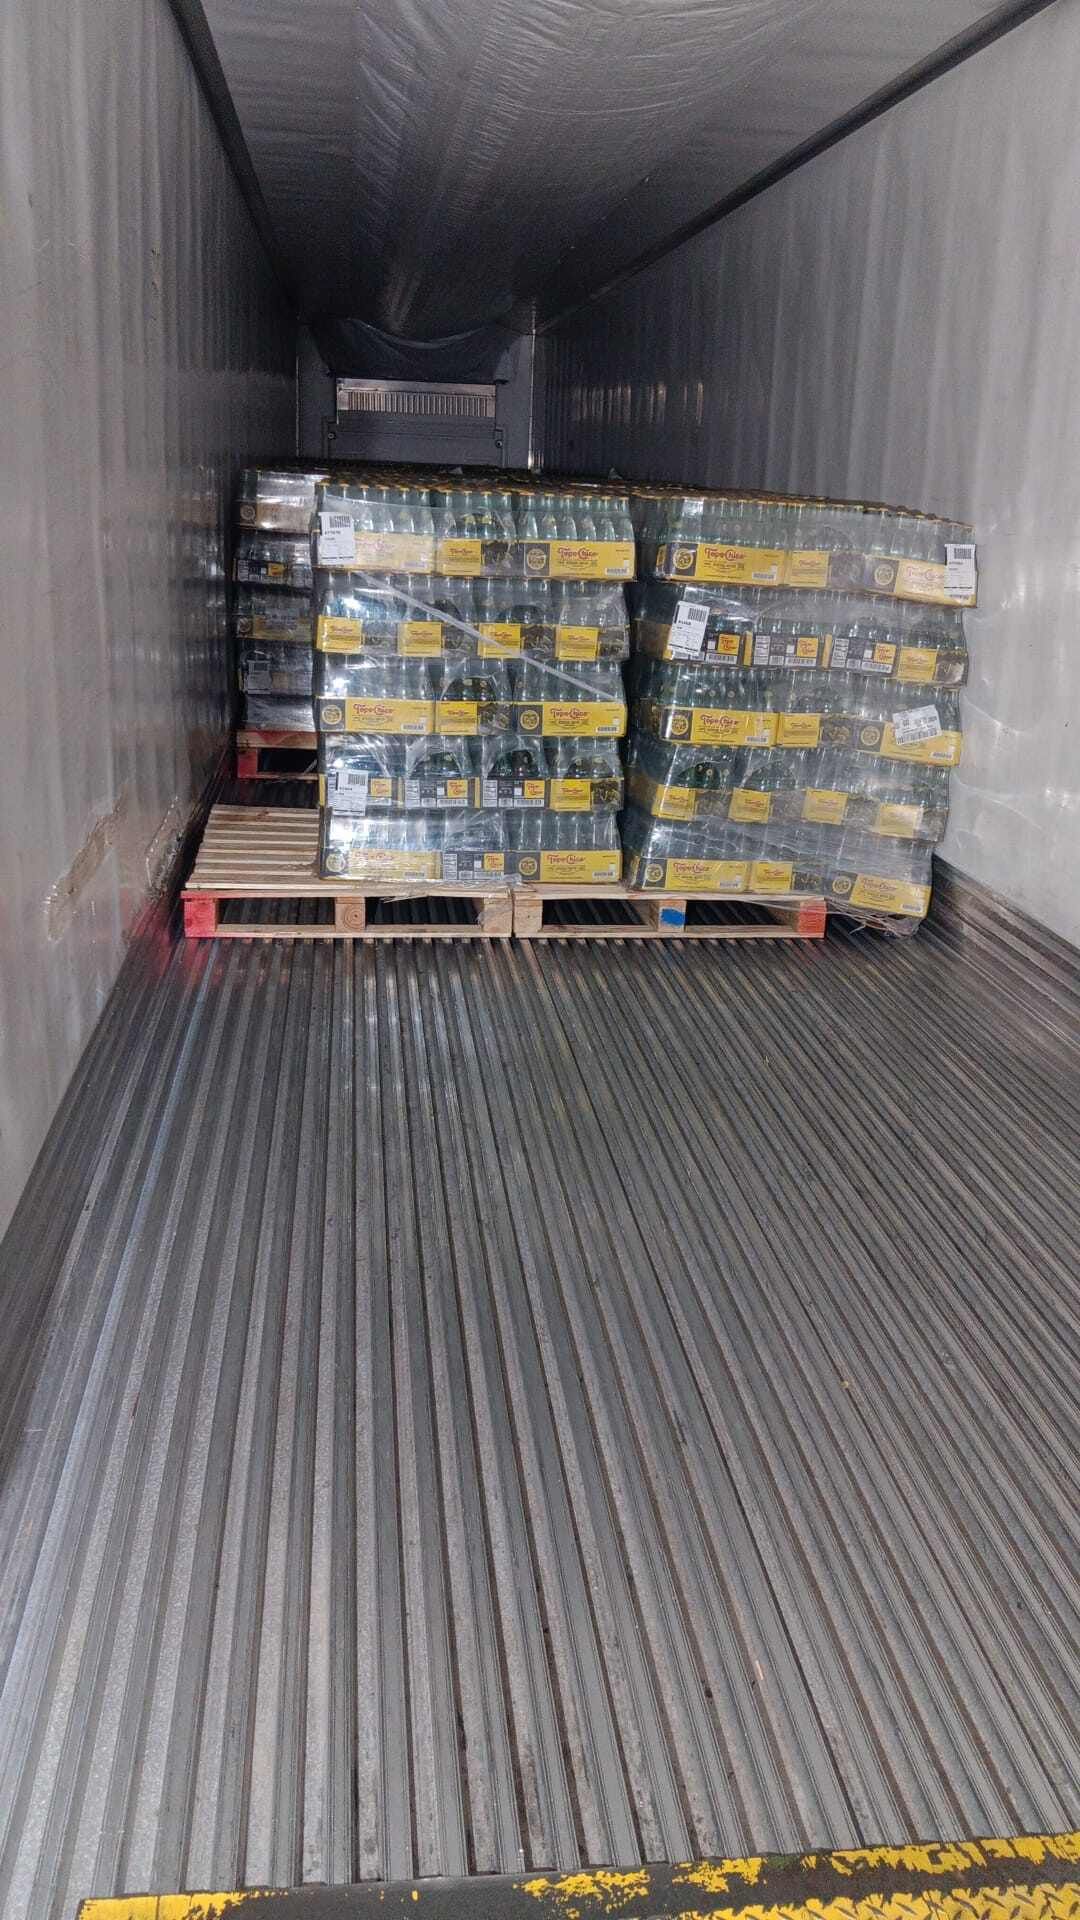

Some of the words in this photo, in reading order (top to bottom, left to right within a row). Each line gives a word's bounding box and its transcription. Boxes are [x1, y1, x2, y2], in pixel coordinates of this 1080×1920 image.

[704, 548, 726, 559] Topo
[725, 549, 746, 561] Chico
[353, 703, 375, 715] Topo
[701, 714, 720, 726] Topo
[547, 854, 568, 865] Topo
[567, 854, 586, 865] Chico
